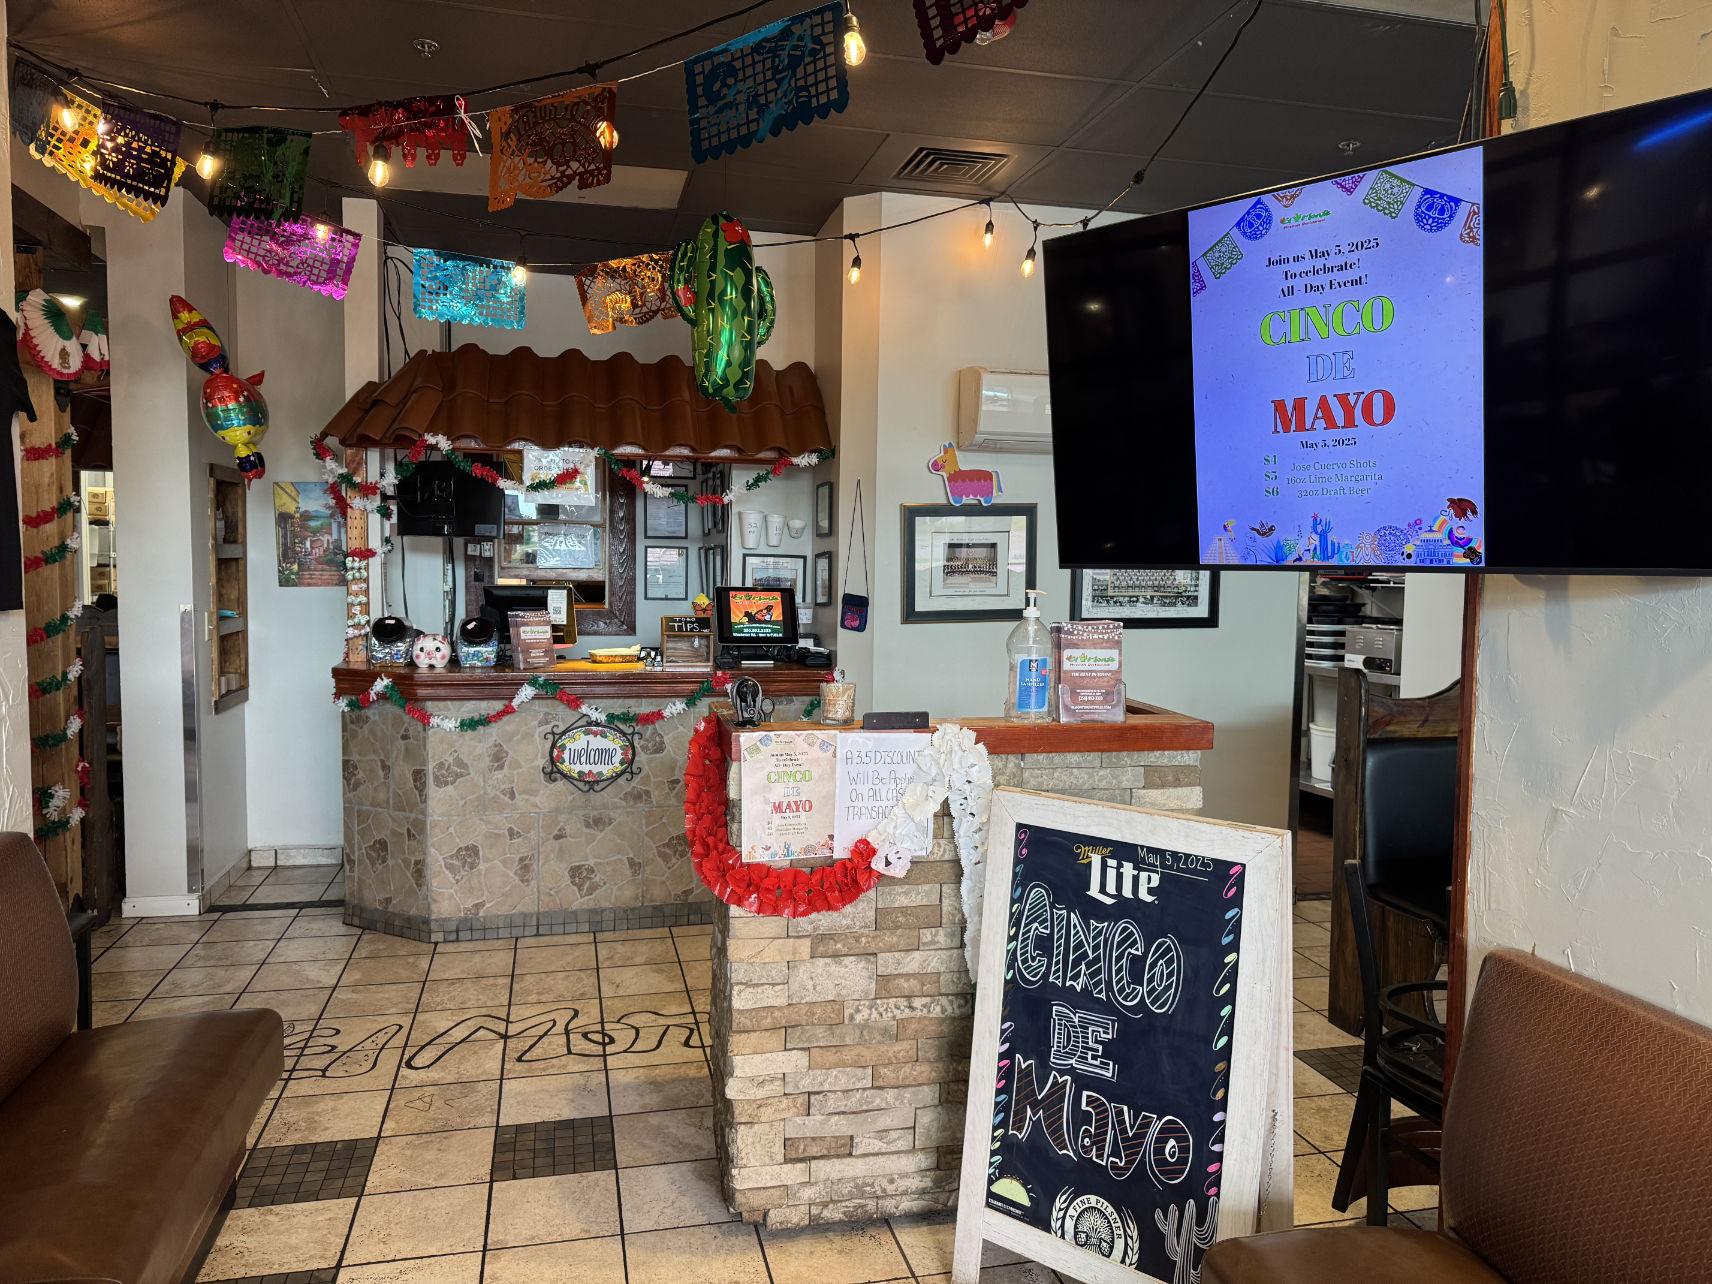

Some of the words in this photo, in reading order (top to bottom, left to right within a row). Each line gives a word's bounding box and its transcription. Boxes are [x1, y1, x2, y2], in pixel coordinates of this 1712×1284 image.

[1265, 254, 1290, 268] Join
[1292, 253, 1306, 263] us
[1308, 248, 1332, 260] May
[1334, 244, 1345, 257] 5,
[1347, 237, 1380, 254] 2025
[1283, 269, 1297, 281] To
[1298, 257, 1361, 279] celebrate!
[1279, 285, 1295, 298] All
[1304, 282, 1327, 295] Day
[1329, 273, 1368, 290] Event!
[1259, 295, 1395, 346] CINCO
[1306, 350, 1355, 383] DE
[1271, 389, 1396, 434] MAYO
[1299, 440, 1319, 451] May
[1331, 437, 1357, 448] 2025
[1290, 462, 1311, 472] Jose
[1313, 461, 1347, 471] Cuervo
[1349, 459, 1377, 469] Shots
[1264, 470, 1278, 482] $5
[1286, 476, 1307, 485] 16oz
[1309, 474, 1333, 484] Lime
[1334, 471, 1383, 484] Margarita
[1264, 486, 1280, 498] $6
[1297, 488, 1319, 499] 32oz
[1321, 486, 1346, 496] Draft
[1348, 486, 1371, 495] Beer
[568, 739, 617, 766] welcome
[845, 749, 854, 766] A
[855, 750, 872, 765] 3.5
[766, 769, 813, 784] CINCO
[847, 769, 869, 786] Will
[871, 769, 887, 786] Be
[783, 786, 801, 797] DE
[849, 788, 864, 803] On
[867, 787, 884, 802] ALL
[886, 787, 906, 802] CAS
[770, 799, 813, 815] MAYO
[1073, 843, 1113, 863] Miller
[1137, 845, 1161, 877] May
[1085, 852, 1160, 905] Lite
[1016, 885, 1181, 1016] CINCO
[1050, 1002, 1117, 1081] DE
[1068, 1214, 1075, 1222] A
[1073, 1196, 1092, 1213] FINE
[1095, 1198, 1123, 1241] PILSNER
